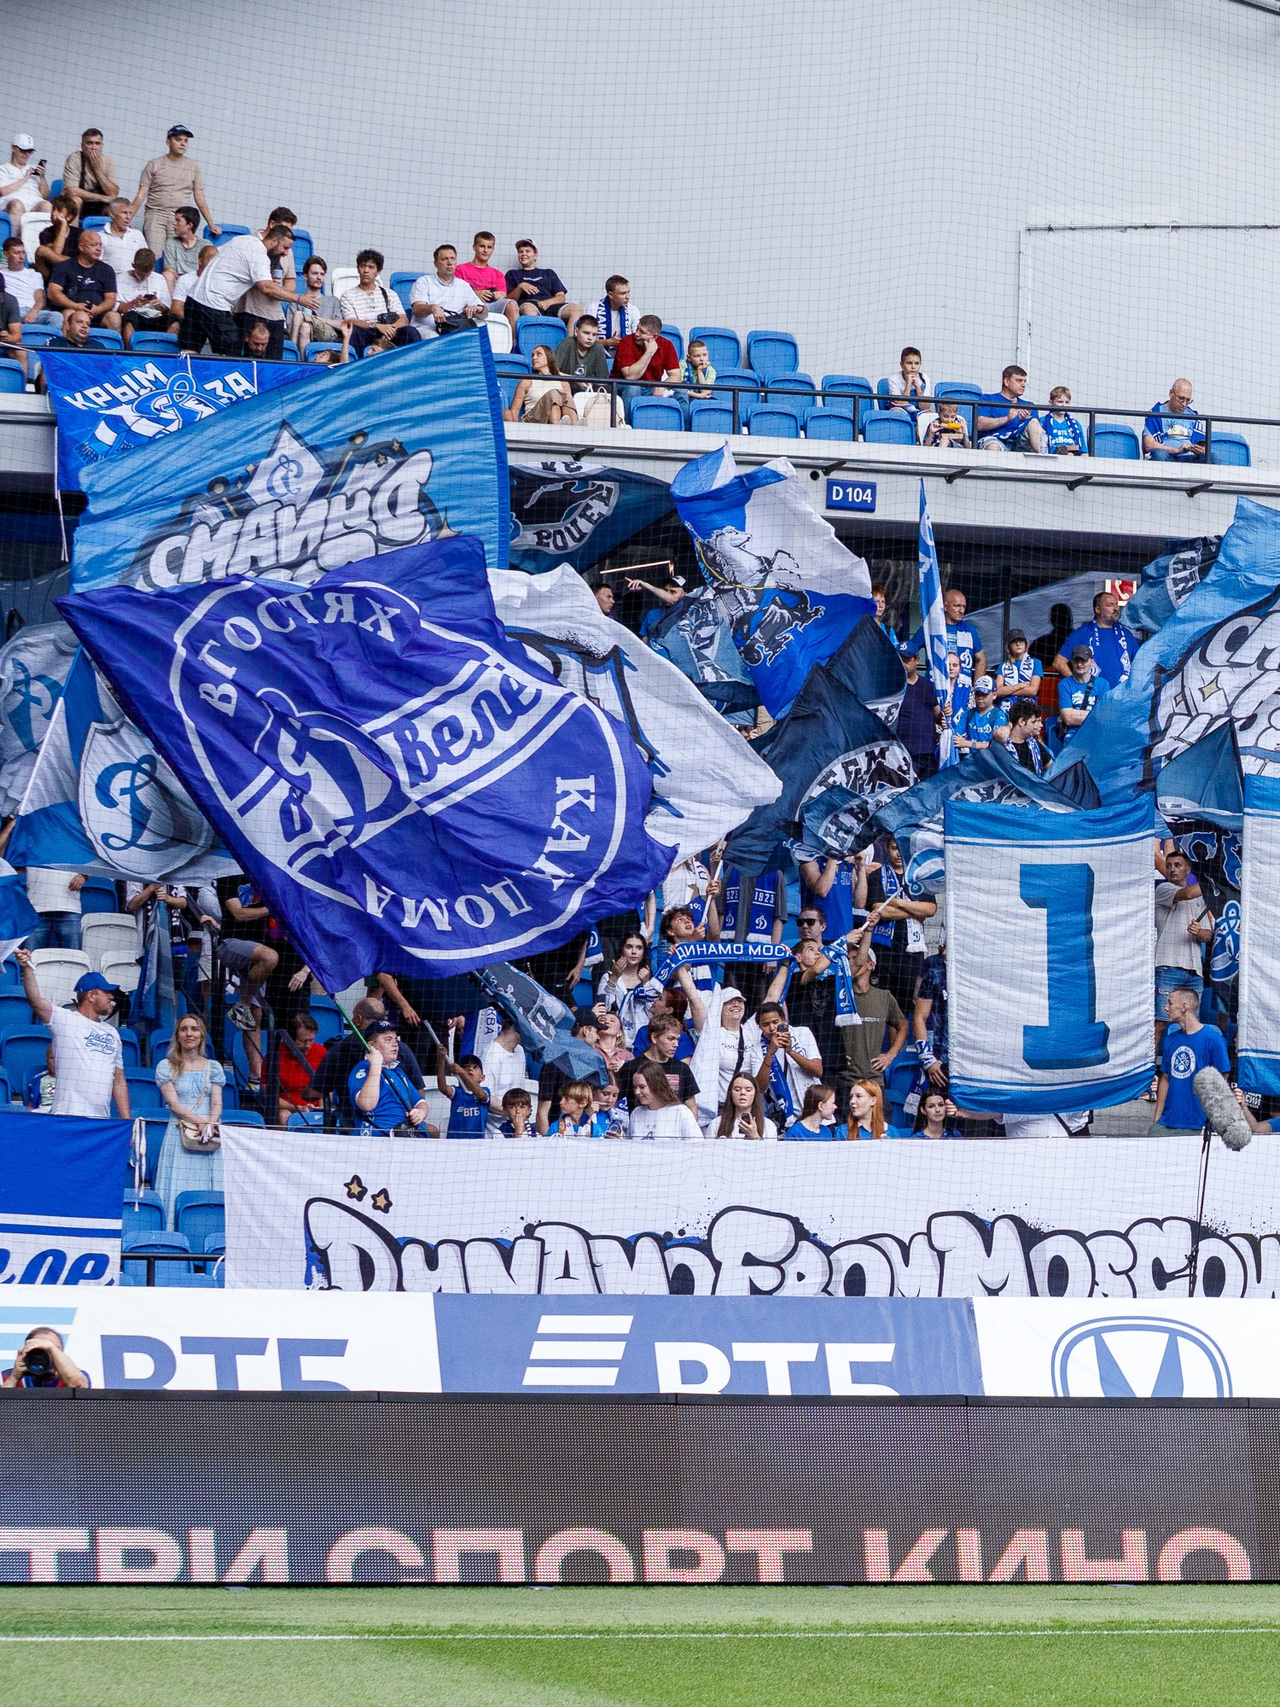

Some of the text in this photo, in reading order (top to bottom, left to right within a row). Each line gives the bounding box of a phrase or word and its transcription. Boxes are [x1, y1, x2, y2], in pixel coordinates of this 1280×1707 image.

[63, 361, 258, 410] КРЫМ ЗА
[832, 487, 873, 503] D 104
[198, 591, 402, 717] В ГОСТЯХ
[521, 774, 597, 890] КАК
[363, 872, 533, 932] ДОМА
[754, 892, 775, 904] 1923
[676, 943, 744, 961] ДИНАМО
[1019, 862, 1110, 1070] 1
[463, 1107, 480, 1117] ВТБ
[304, 1197, 714, 1294] DYNAMO
[100, 1334, 350, 1391] ВТБ
[654, 1342, 900, 1395] ВТБ
[326, 1526, 813, 1583] СПОРТ
[862, 1526, 1252, 1583] КИНО
